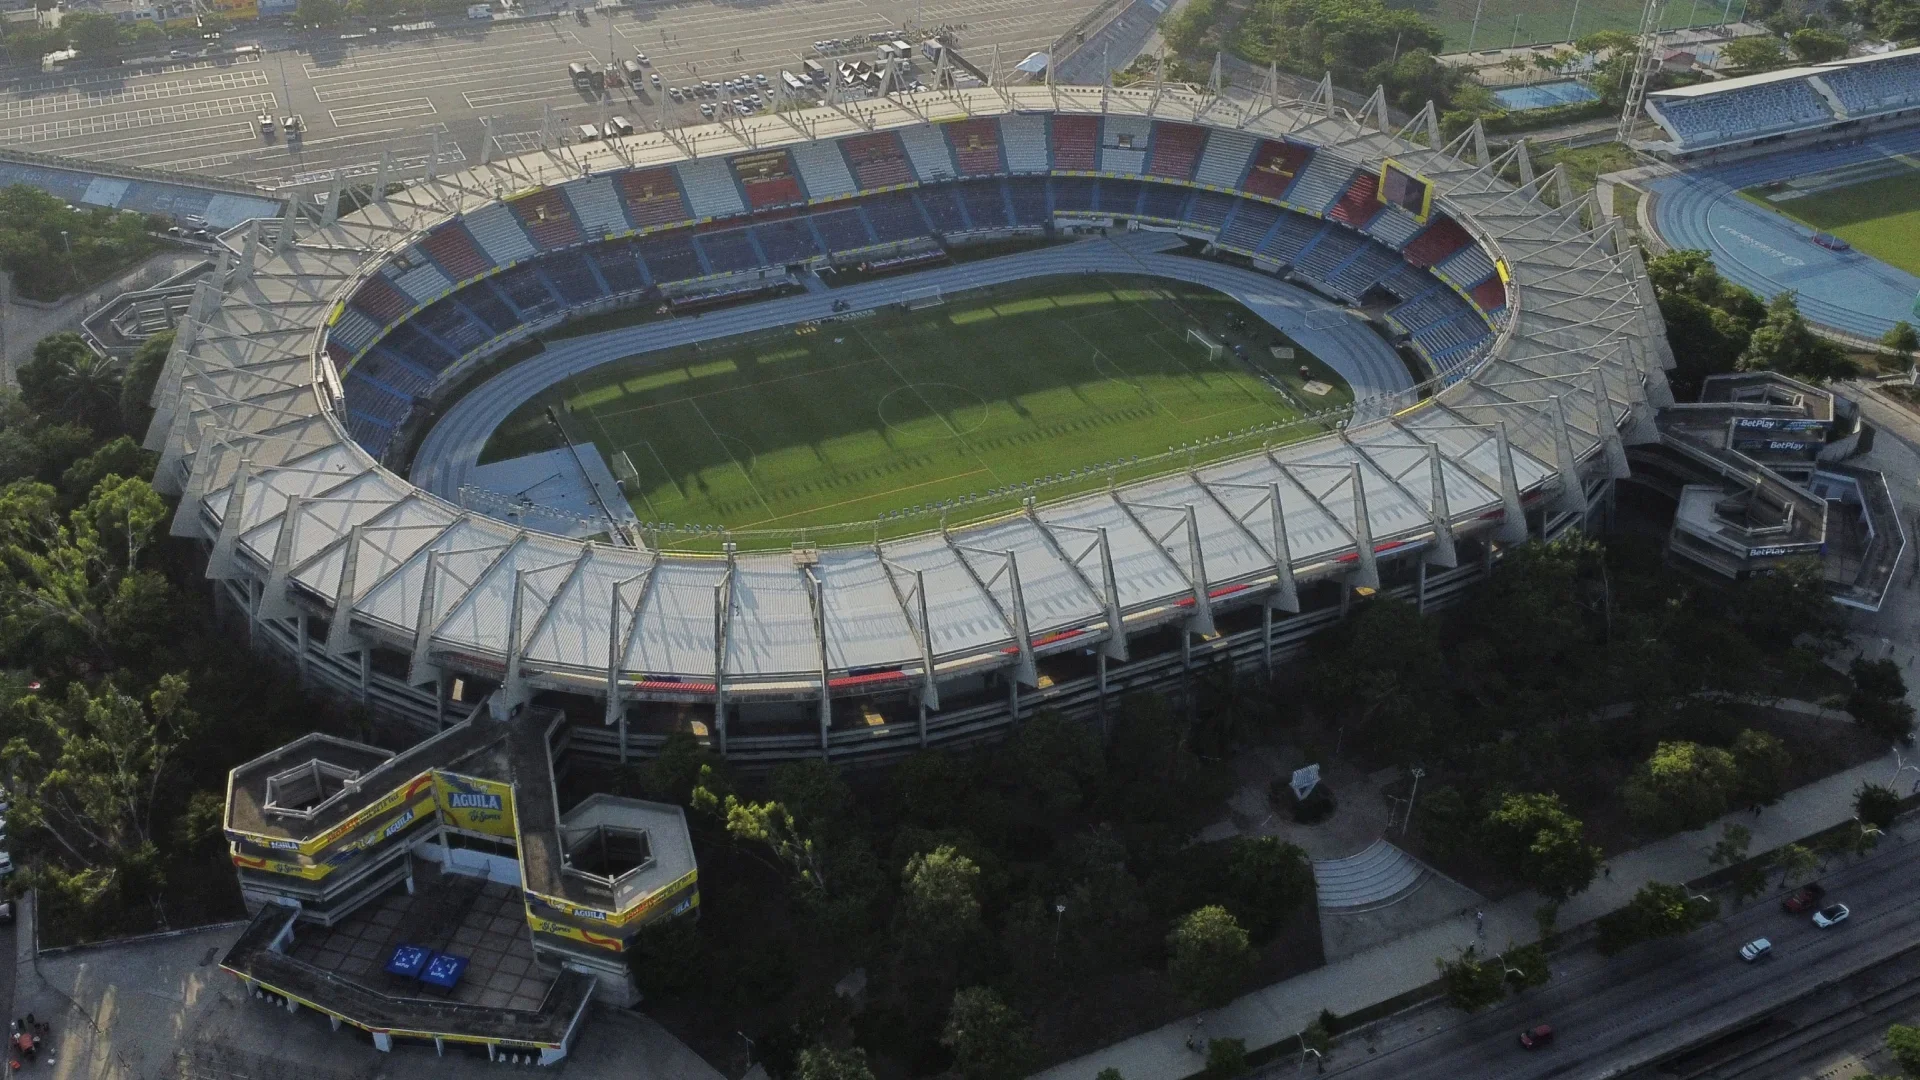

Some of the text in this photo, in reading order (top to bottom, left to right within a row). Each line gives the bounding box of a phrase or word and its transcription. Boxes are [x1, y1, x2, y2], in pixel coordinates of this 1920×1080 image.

[1741, 419, 1775, 429] BetPlay
[1770, 441, 1804, 451] BetPlay
[1750, 548, 1786, 557] BetPlay
